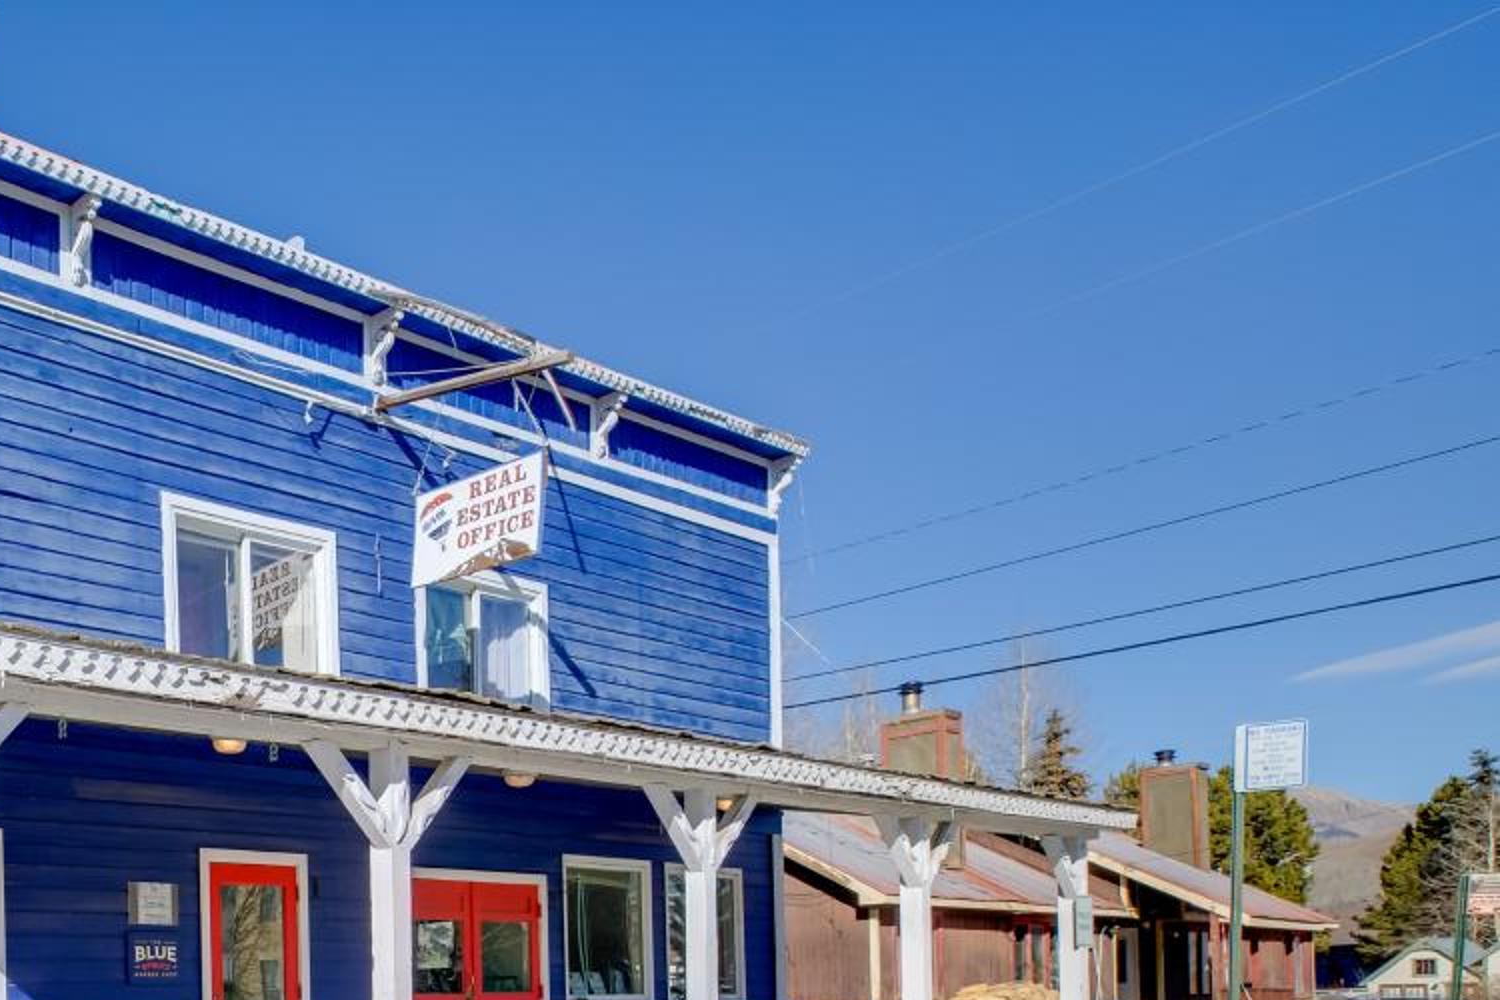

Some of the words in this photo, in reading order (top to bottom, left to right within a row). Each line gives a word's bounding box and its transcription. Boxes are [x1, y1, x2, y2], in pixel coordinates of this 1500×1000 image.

[469, 464, 527, 500] REAL
[456, 486, 535, 526] ESTATE
[457, 510, 533, 549] OFFICE
[134, 945, 177, 962] BLUE
